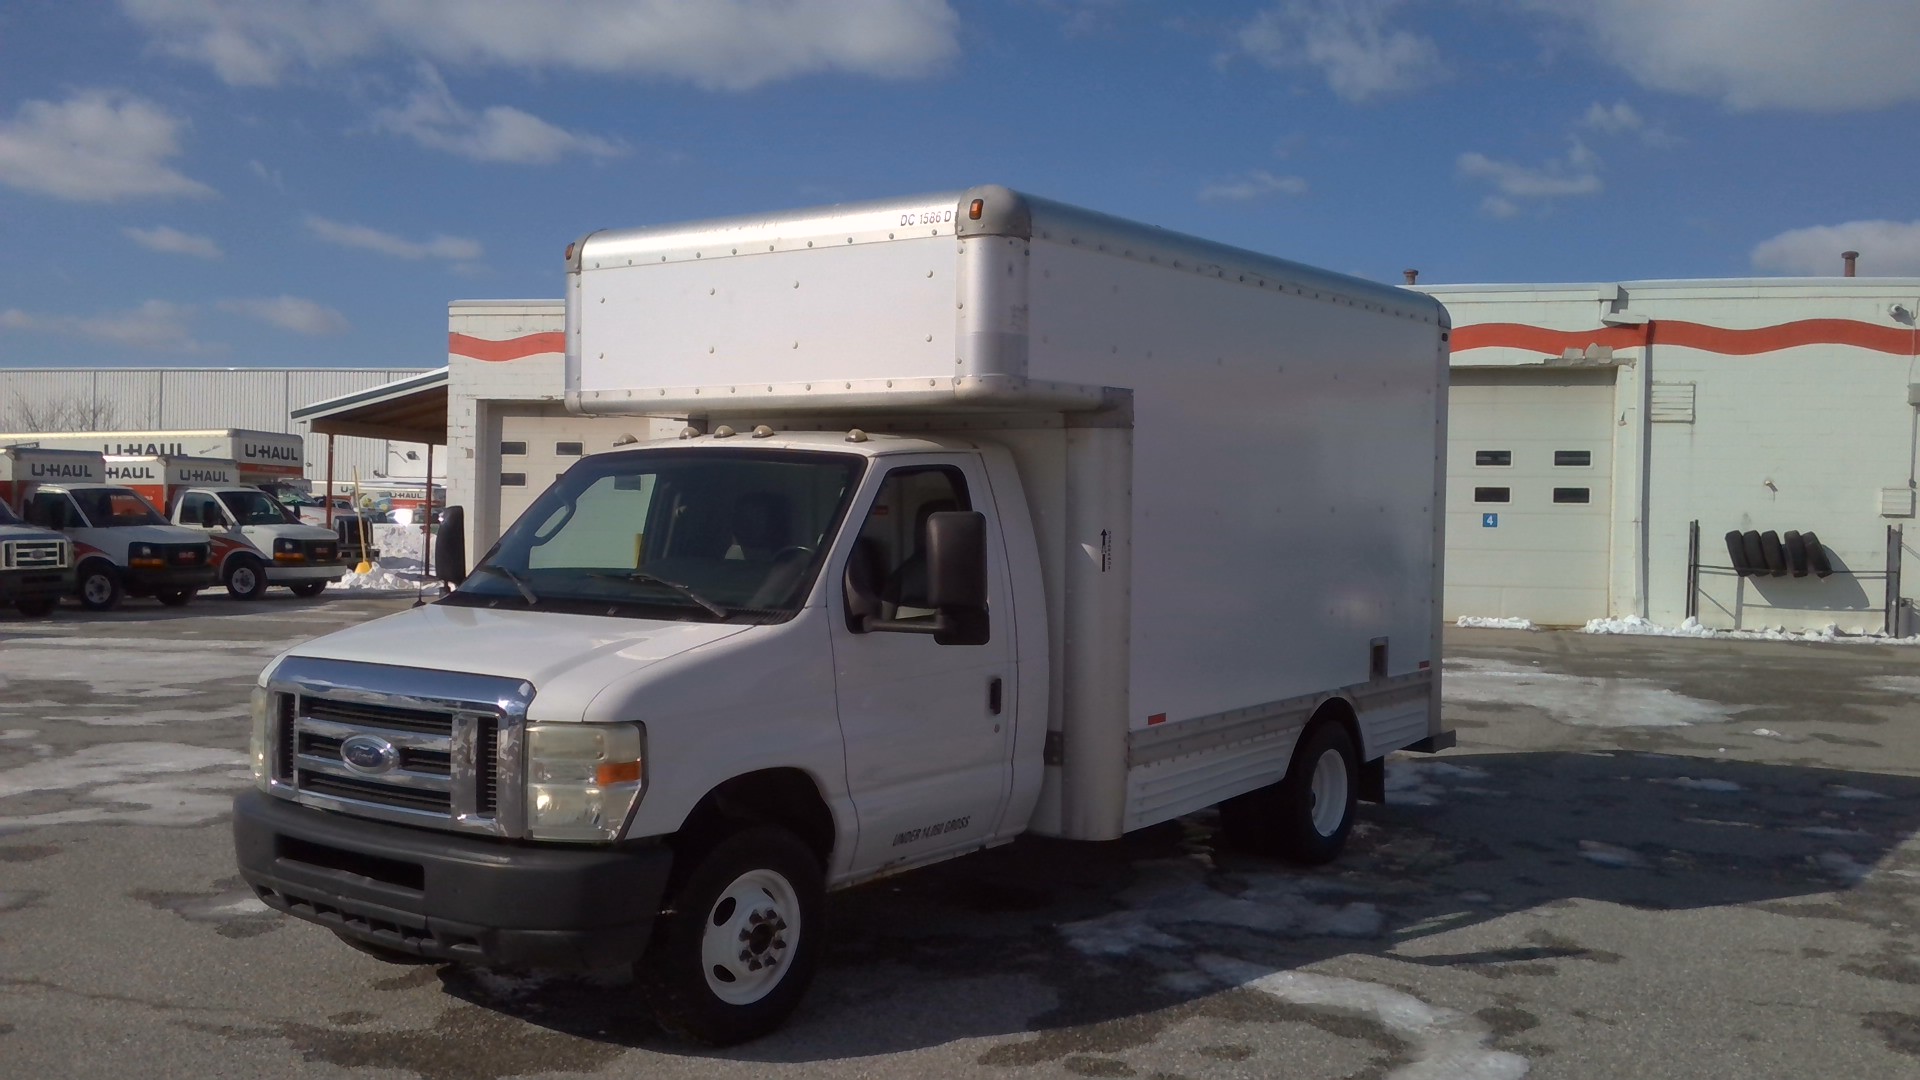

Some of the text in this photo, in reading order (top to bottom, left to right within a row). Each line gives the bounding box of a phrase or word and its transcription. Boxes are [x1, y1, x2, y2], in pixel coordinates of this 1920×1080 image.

[900, 213, 915, 226] DC
[920, 211, 941, 224] 1586
[244, 443, 299, 461] U-HAUL
[31, 463, 93, 478] U-HAUL
[105, 467, 155, 479] -HAUL
[180, 469, 230, 483] U-HAUL
[1486, 515, 1494, 526] 4
